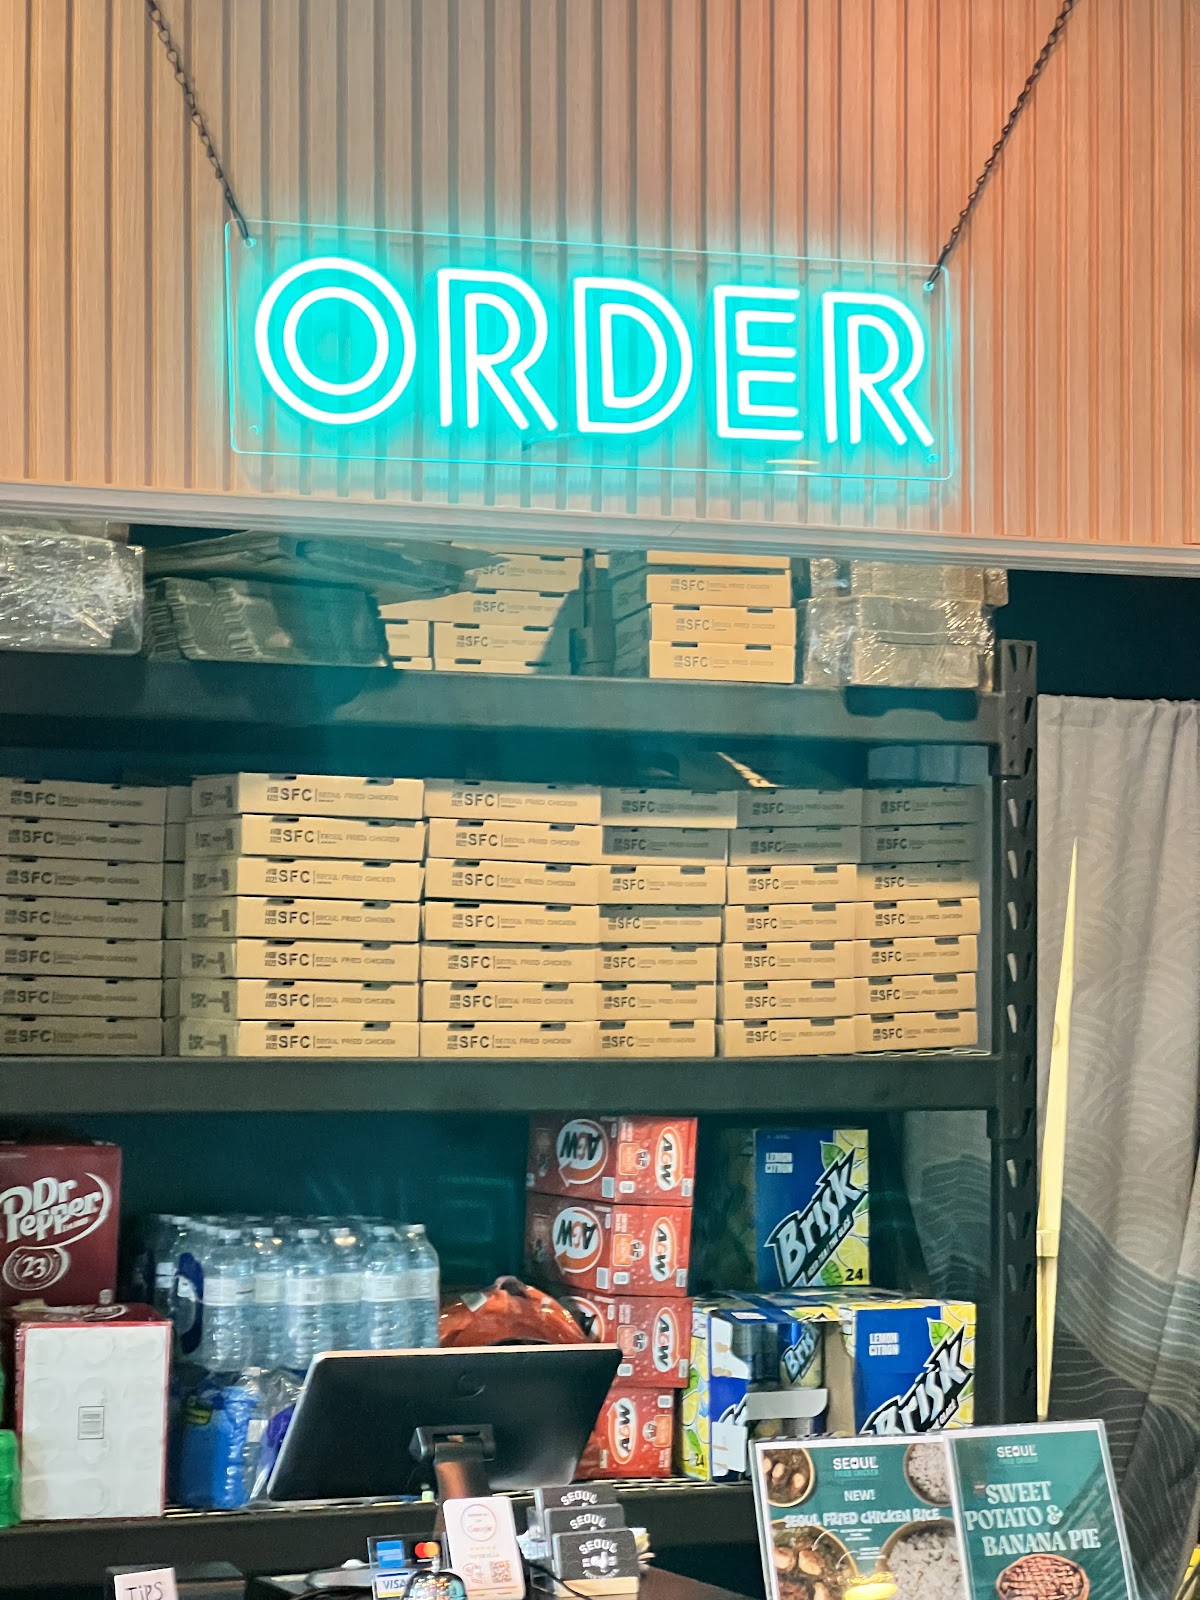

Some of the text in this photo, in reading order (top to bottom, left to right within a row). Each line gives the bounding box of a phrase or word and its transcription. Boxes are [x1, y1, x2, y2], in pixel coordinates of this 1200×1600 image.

[255, 255, 935, 447] ORDER
[680, 580, 705, 591] SFC
[481, 601, 505, 613] SFC
[685, 619, 710, 630] SFC
[465, 636, 488, 647] SFC
[683, 656, 708, 668] SFC
[23, 792, 56, 805] SFC
[280, 788, 312, 801] SFC
[464, 793, 495, 807] SFC
[631, 801, 655, 813] SFC
[761, 803, 784, 814] SFC
[888, 801, 910, 812] SFC
[22, 830, 54, 844] SFC
[283, 829, 314, 843] SFC
[467, 833, 498, 847] SFC
[624, 839, 647, 850] SFC
[760, 841, 782, 853] SFC
[886, 839, 907, 850] SFC
[20, 872, 52, 884] SFC
[278, 870, 310, 883] SFC
[464, 873, 495, 887] SFC
[883, 876, 905, 888] SFC
[622, 879, 645, 890] SFC
[758, 878, 779, 890] SFC
[18, 911, 51, 924] SFC
[278, 911, 310, 924] SFC
[465, 915, 495, 927] SFC
[617, 918, 641, 929] SFC
[755, 918, 778, 929] SFC
[883, 913, 905, 925] SFC
[19, 950, 50, 963] SFC
[278, 953, 310, 966] SFC
[460, 956, 490, 968] SFC
[613, 957, 635, 968] SFC
[754, 956, 776, 967] SFC
[880, 951, 902, 962] SFC
[17, 990, 49, 1004] SFC
[278, 994, 310, 1007] SFC
[879, 989, 900, 1000] SFC
[462, 995, 492, 1008] SFC
[613, 997, 636, 1008] SFC
[754, 996, 777, 1007] SFC
[18, 1030, 51, 1042] SFC
[755, 1031, 777, 1042] SFC
[881, 1028, 903, 1039] SFC
[278, 1035, 310, 1049] SFC
[459, 1036, 489, 1048] SFC
[611, 1036, 634, 1047] SFC
[559, 1131, 600, 1160] A&W
[660, 1136, 673, 1186] A&W
[32, 1177, 78, 1213] Dr
[0, 1186, 101, 1243] Pepper
[556, 1219, 597, 1249] A&W
[654, 1227, 667, 1277] A&W
[21, 1256, 47, 1278] 23
[846, 1268, 864, 1281] 24
[658, 1317, 671, 1368] A&W
[618, 1405, 631, 1453] A&W
[997, 1445, 1038, 1458] SEOUL
[695, 1454, 704, 1466] 24
[833, 1456, 879, 1470] SEOUL
[560, 1490, 598, 1506] SEOUL
[844, 1489, 876, 1502] NEW!
[985, 1481, 1052, 1505] SWEET
[569, 1513, 607, 1530] SEOUL
[823, 1511, 858, 1526] FRIED
[861, 1509, 911, 1524] CHICKEN
[913, 1508, 941, 1522] RICE
[964, 1505, 1064, 1531] POTATO &
[578, 1538, 618, 1555] SEOUL
[982, 1528, 1101, 1557] BANANA PIE
